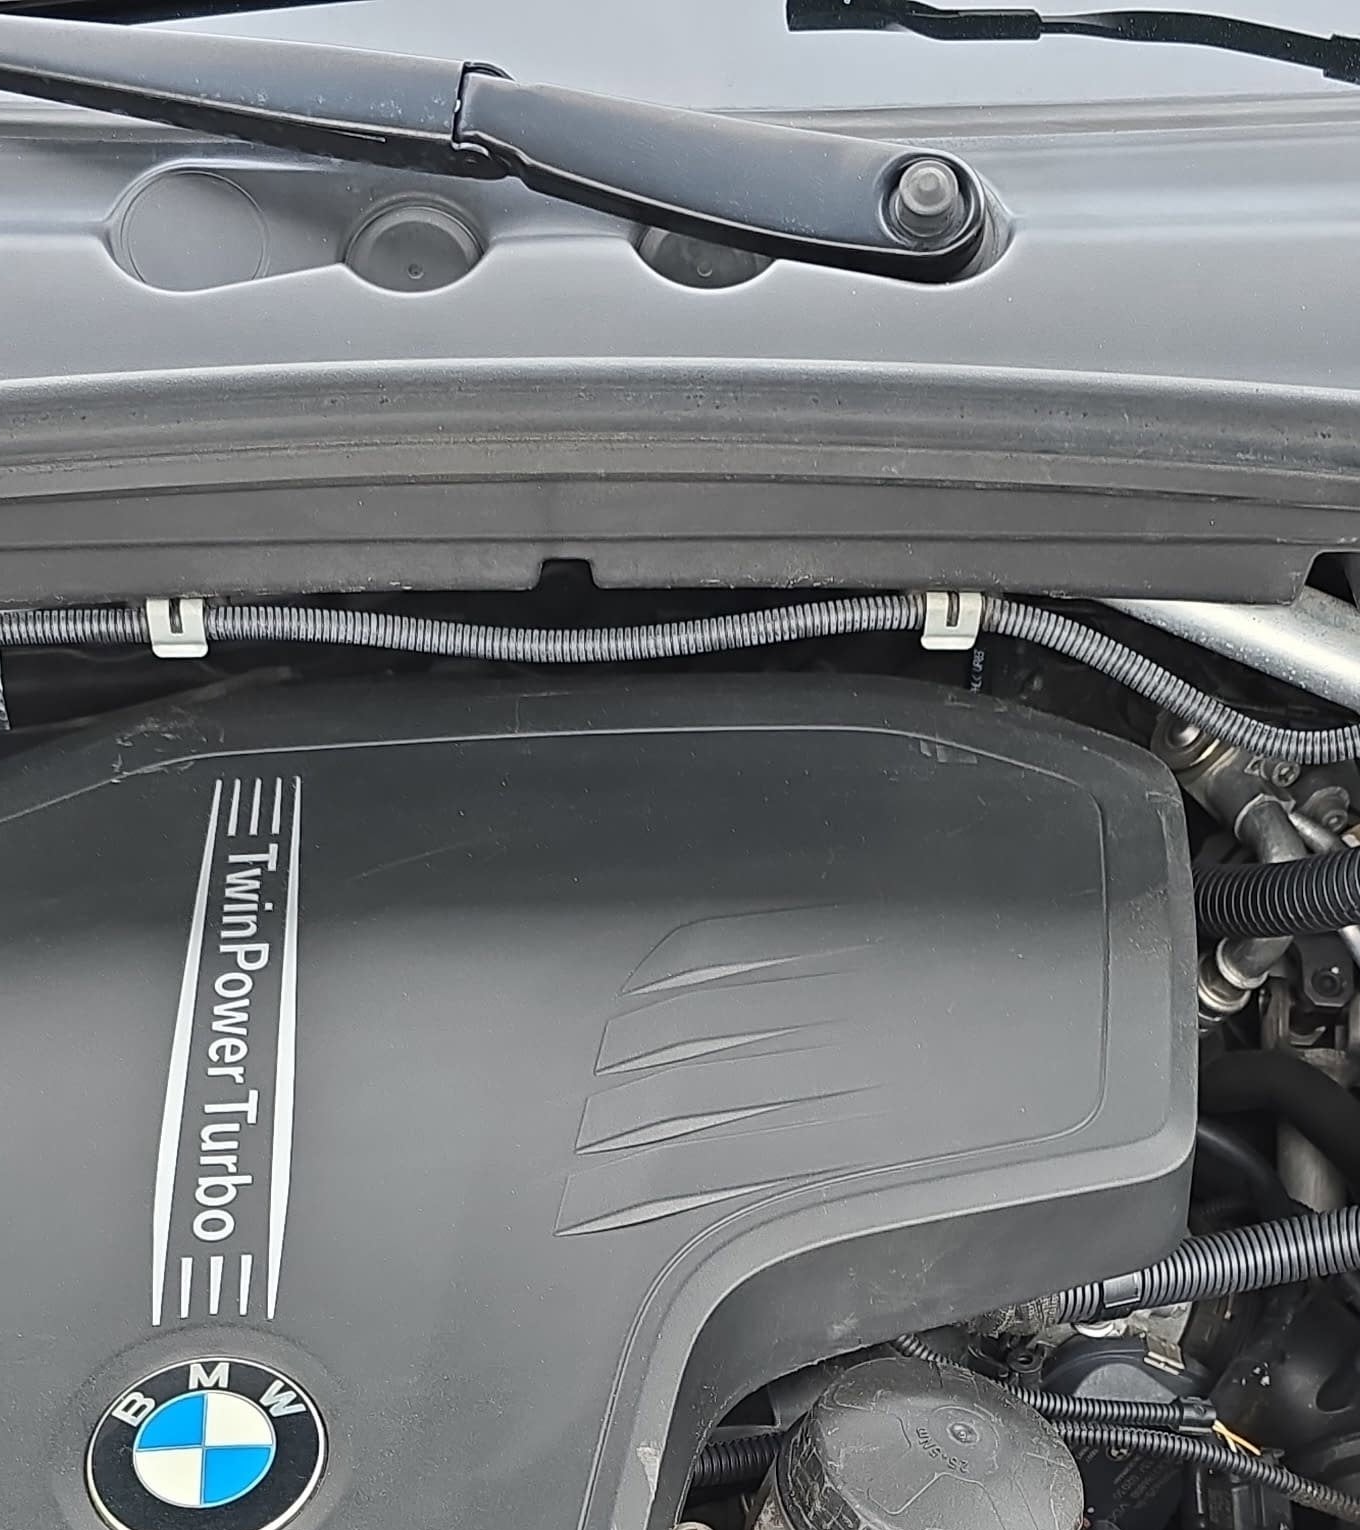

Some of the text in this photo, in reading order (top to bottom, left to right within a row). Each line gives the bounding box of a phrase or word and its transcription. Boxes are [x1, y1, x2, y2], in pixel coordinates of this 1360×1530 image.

[192, 843, 278, 1242] TwinPower Turbo
[112, 1362, 306, 1427] BMW
